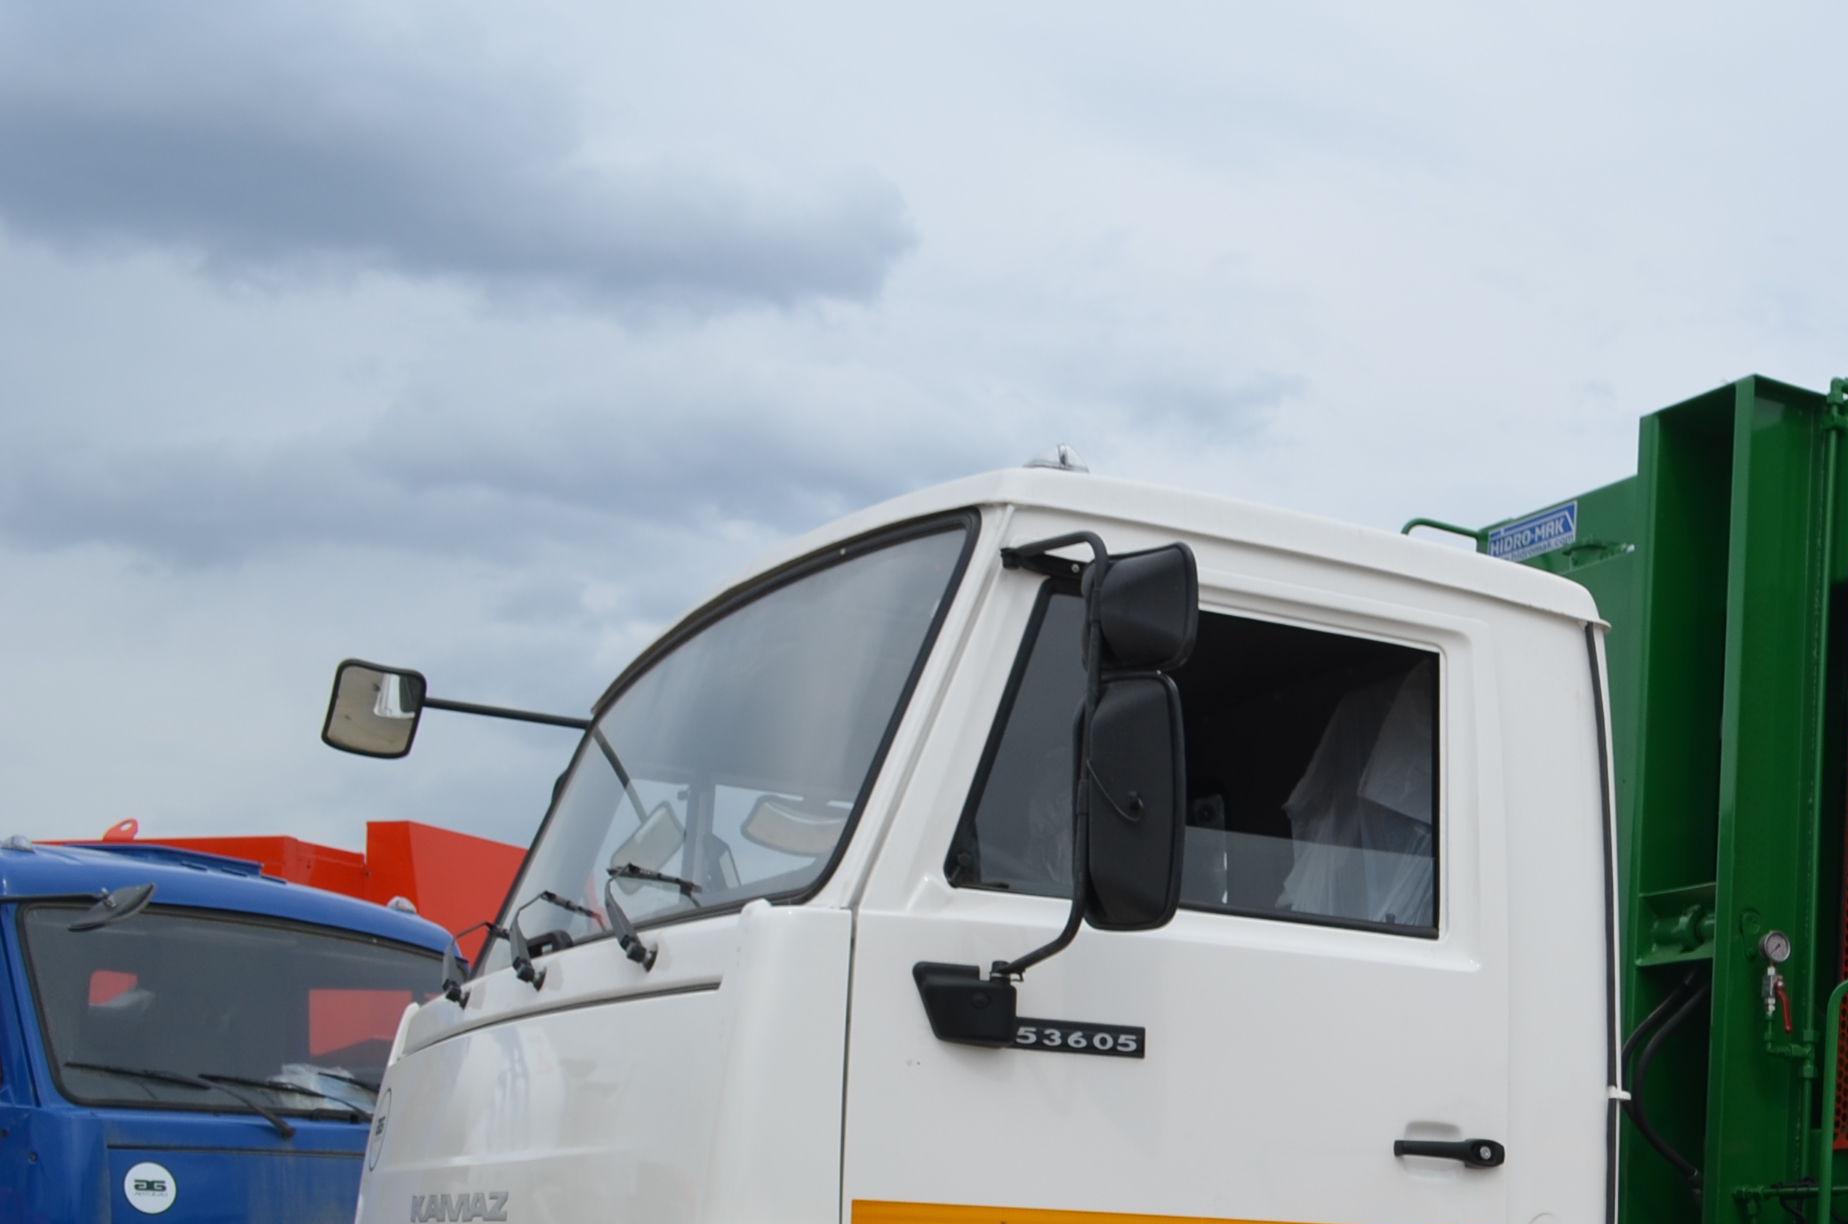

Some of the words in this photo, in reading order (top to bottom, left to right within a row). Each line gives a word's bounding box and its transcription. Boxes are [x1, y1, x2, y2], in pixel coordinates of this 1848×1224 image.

[1490, 517, 1565, 558] HIDRO-MAK
[1015, 1026, 1138, 1052] 53605
[410, 1191, 509, 1223] KAMAZ
